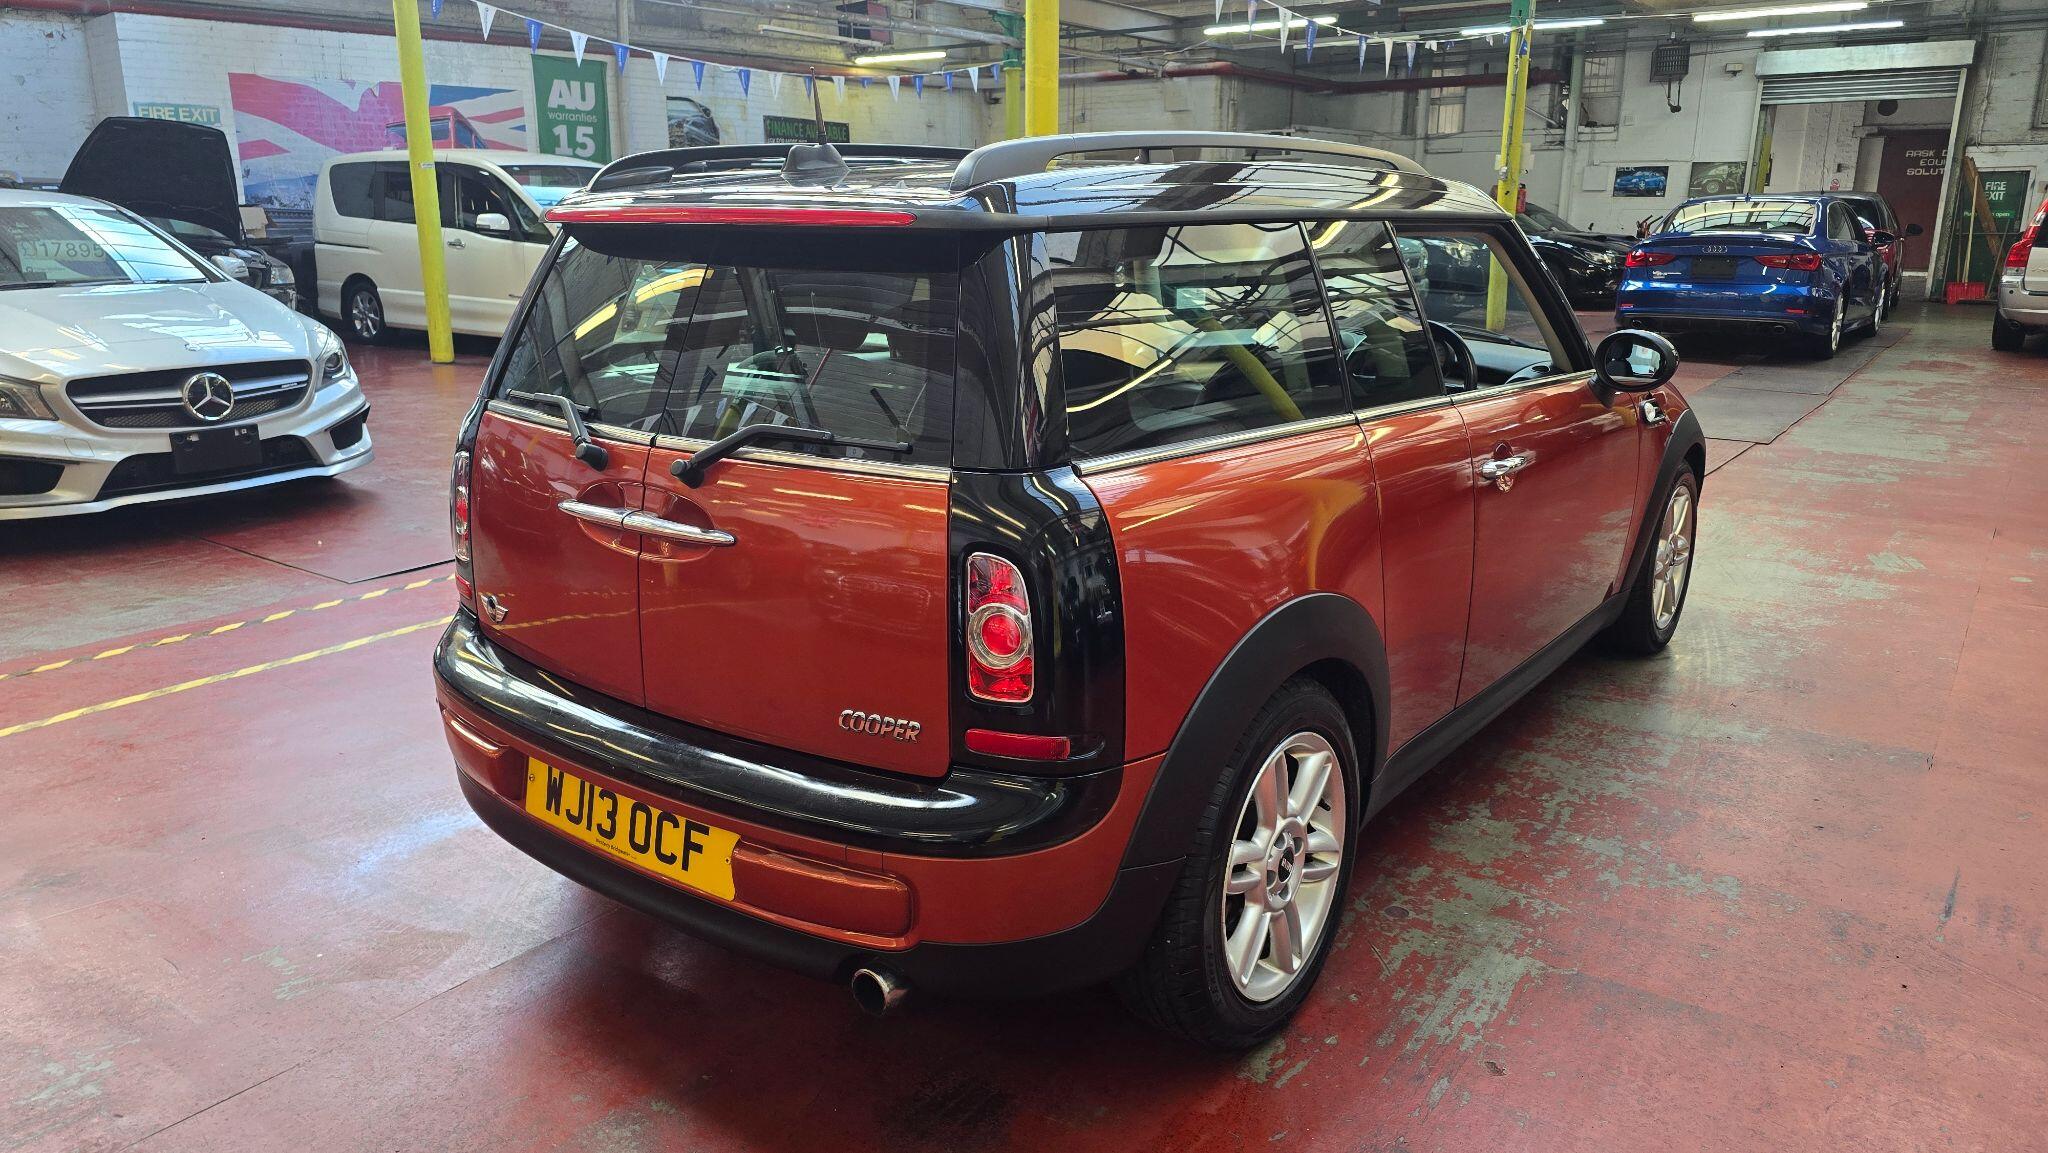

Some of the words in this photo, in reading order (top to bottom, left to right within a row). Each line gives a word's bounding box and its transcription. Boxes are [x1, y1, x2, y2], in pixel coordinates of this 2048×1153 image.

[548, 79, 596, 111] AU
[138, 106, 177, 120] FIRE
[179, 107, 218, 122] EXIT
[548, 112, 598, 123] warranties
[766, 118, 804, 137] FINANCE
[805, 124, 847, 140] AVABLE
[552, 124, 596, 157] 15
[1906, 168, 1946, 176] SOLUT
[1985, 181, 2007, 191] FIRE
[838, 709, 922, 744] COOPER
[545, 765, 619, 841] WJ13
[628, 801, 711, 872] OCF
